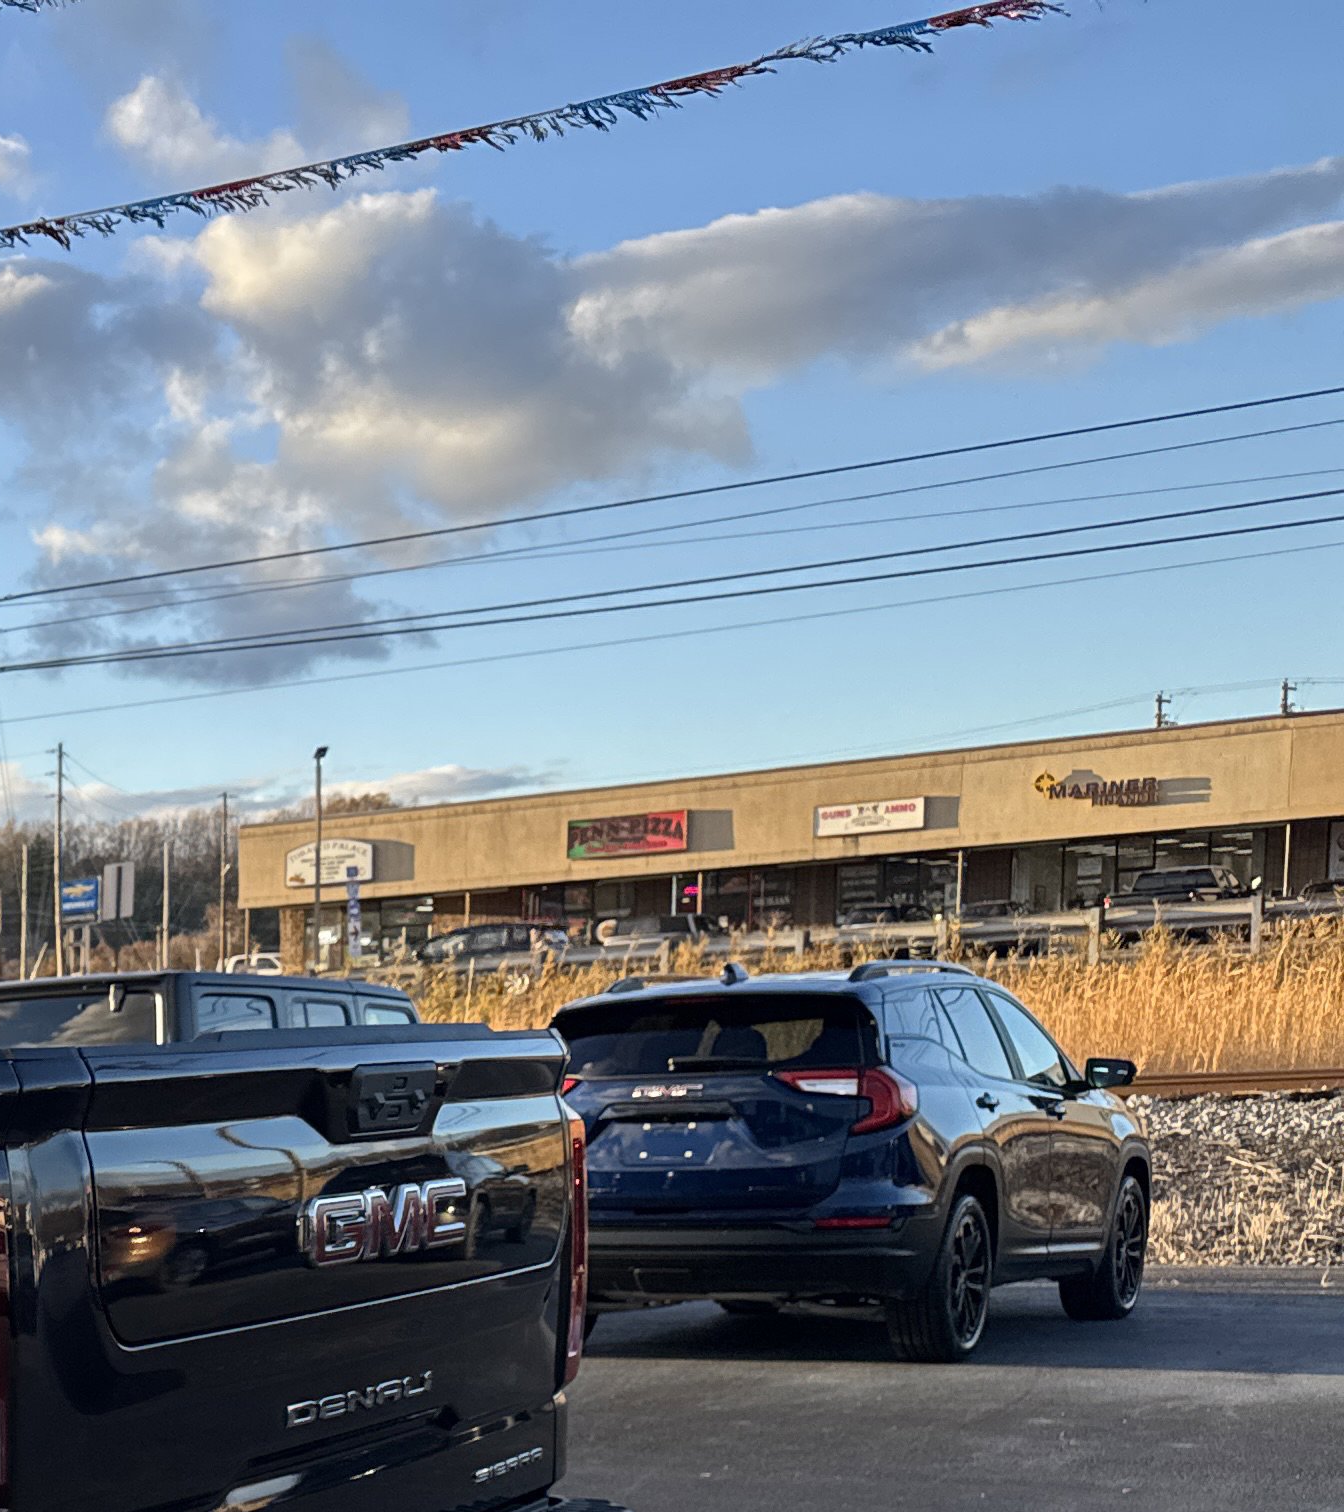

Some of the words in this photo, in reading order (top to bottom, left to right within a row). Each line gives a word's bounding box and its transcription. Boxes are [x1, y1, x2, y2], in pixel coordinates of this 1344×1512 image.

[1048, 777, 1157, 800] MARINER
[821, 809, 852, 821] GUNS
[884, 803, 916, 815] AMMO
[304, 1176, 467, 1267] GMC
[286, 1370, 433, 1429] DENALI
[472, 1447, 543, 1484] SIERRA
